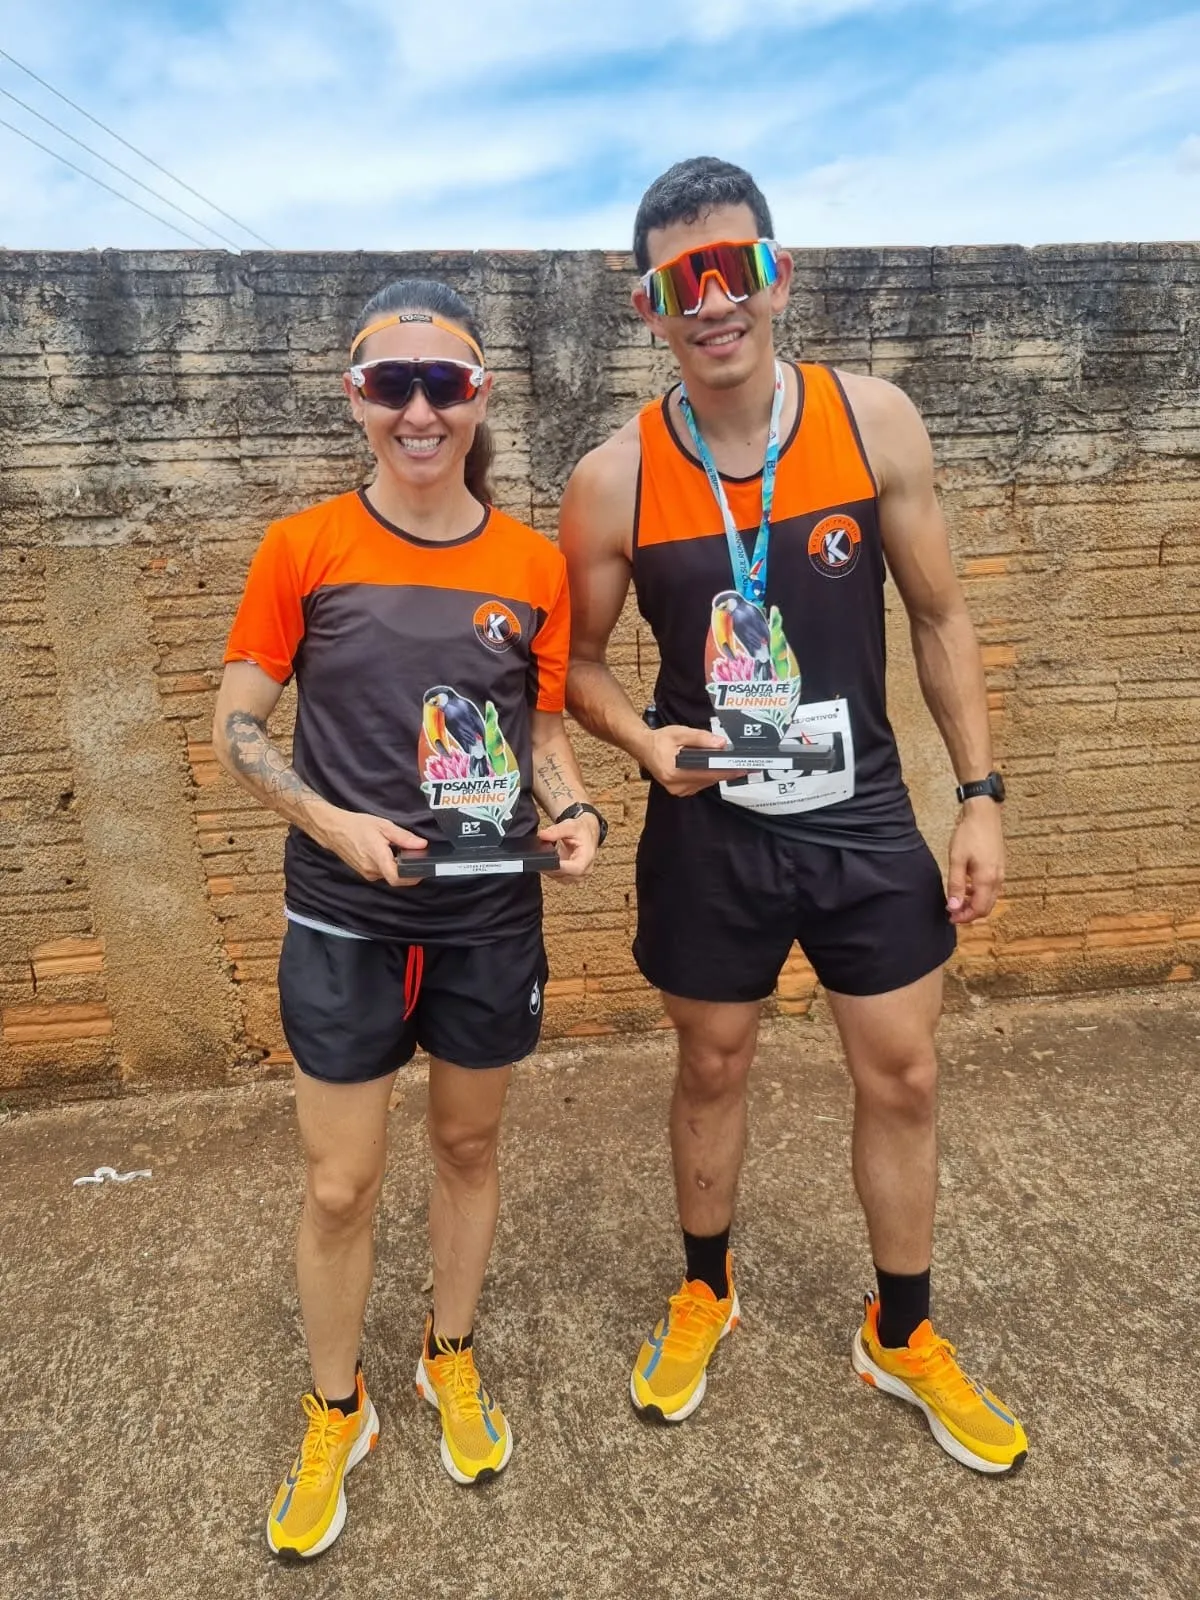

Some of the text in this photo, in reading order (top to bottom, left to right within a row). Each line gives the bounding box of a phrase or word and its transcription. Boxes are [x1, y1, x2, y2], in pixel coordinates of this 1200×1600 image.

[824, 529, 849, 564] K
[488, 613, 507, 641] K
[736, 683, 773, 693] SANTA
[775, 681, 791, 693] FÉ
[726, 697, 787, 706] RUNNING
[743, 723, 762, 736] B3
[451, 780, 491, 791] SANTA
[493, 777, 508, 789] FÉ
[778, 782, 795, 795] B3
[442, 792, 505, 805] RUNNING
[461, 821, 481, 835] B3
